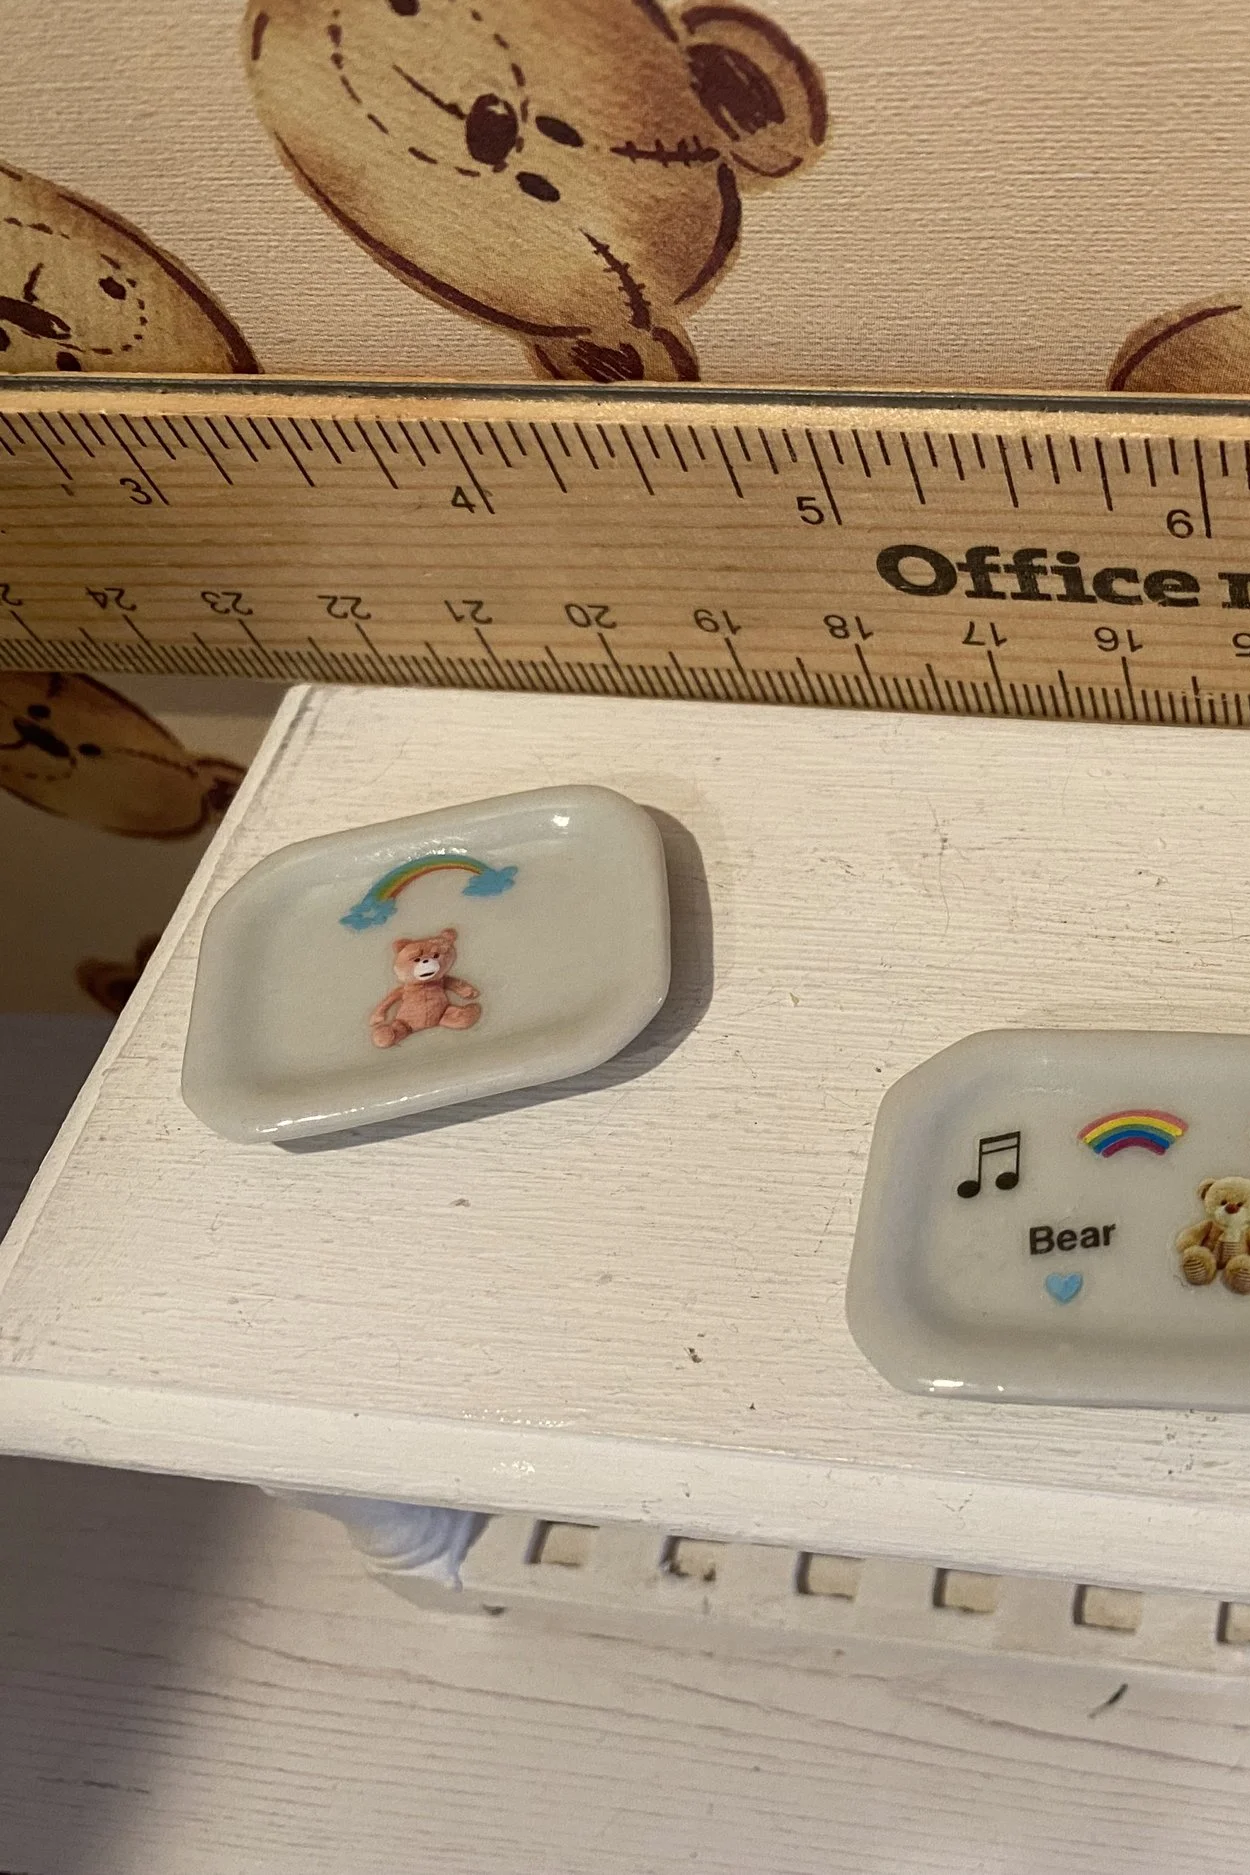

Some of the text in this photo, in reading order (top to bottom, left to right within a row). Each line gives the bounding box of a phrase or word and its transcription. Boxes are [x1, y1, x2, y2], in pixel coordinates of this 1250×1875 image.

[119, 477, 153, 505] 3
[451, 486, 475, 513] 4
[797, 496, 825, 525] 5
[1166, 509, 1194, 538] 6
[876, 544, 1200, 608] Office
[86, 587, 137, 611] 24
[200, 590, 254, 617] 23
[317, 594, 372, 621] 22
[444, 599, 494, 625] 21
[565, 603, 617, 630] 20
[694, 609, 742, 636] 19
[823, 614, 874, 641] 18
[962, 621, 1008, 647] 17
[1094, 626, 1143, 653] 16
[1029, 1223, 1116, 1255] Bear
